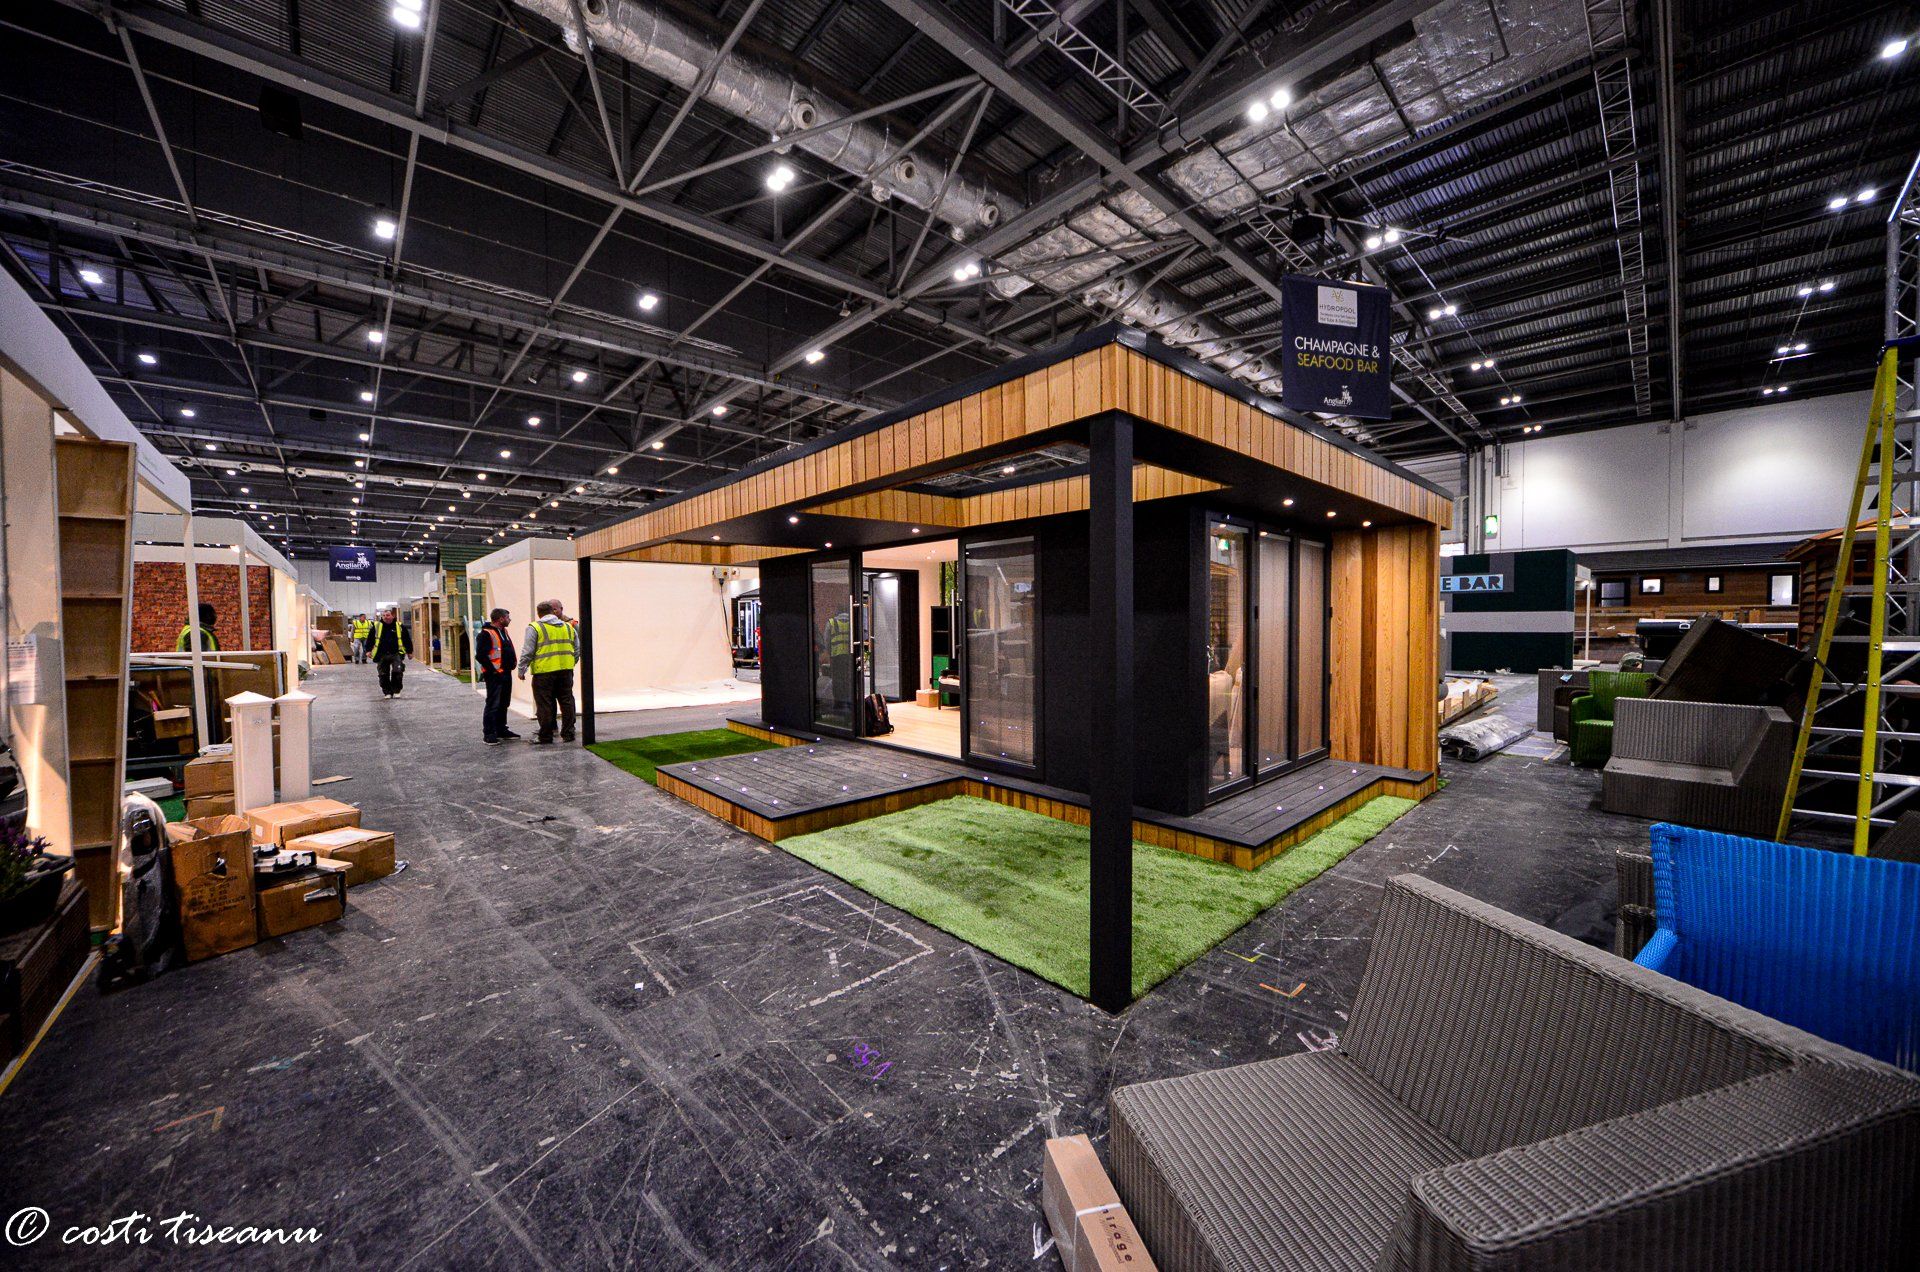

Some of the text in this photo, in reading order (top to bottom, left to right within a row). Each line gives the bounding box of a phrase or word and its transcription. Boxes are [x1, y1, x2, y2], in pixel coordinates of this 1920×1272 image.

[1319, 304, 1356, 314] HYDROPOOL
[1294, 336, 1380, 359] CHAMPAGNE &
[1297, 352, 1378, 374] SEAFOOD BAR
[335, 562, 362, 570] Anglian
[1442, 575, 1501, 591] E BAR
